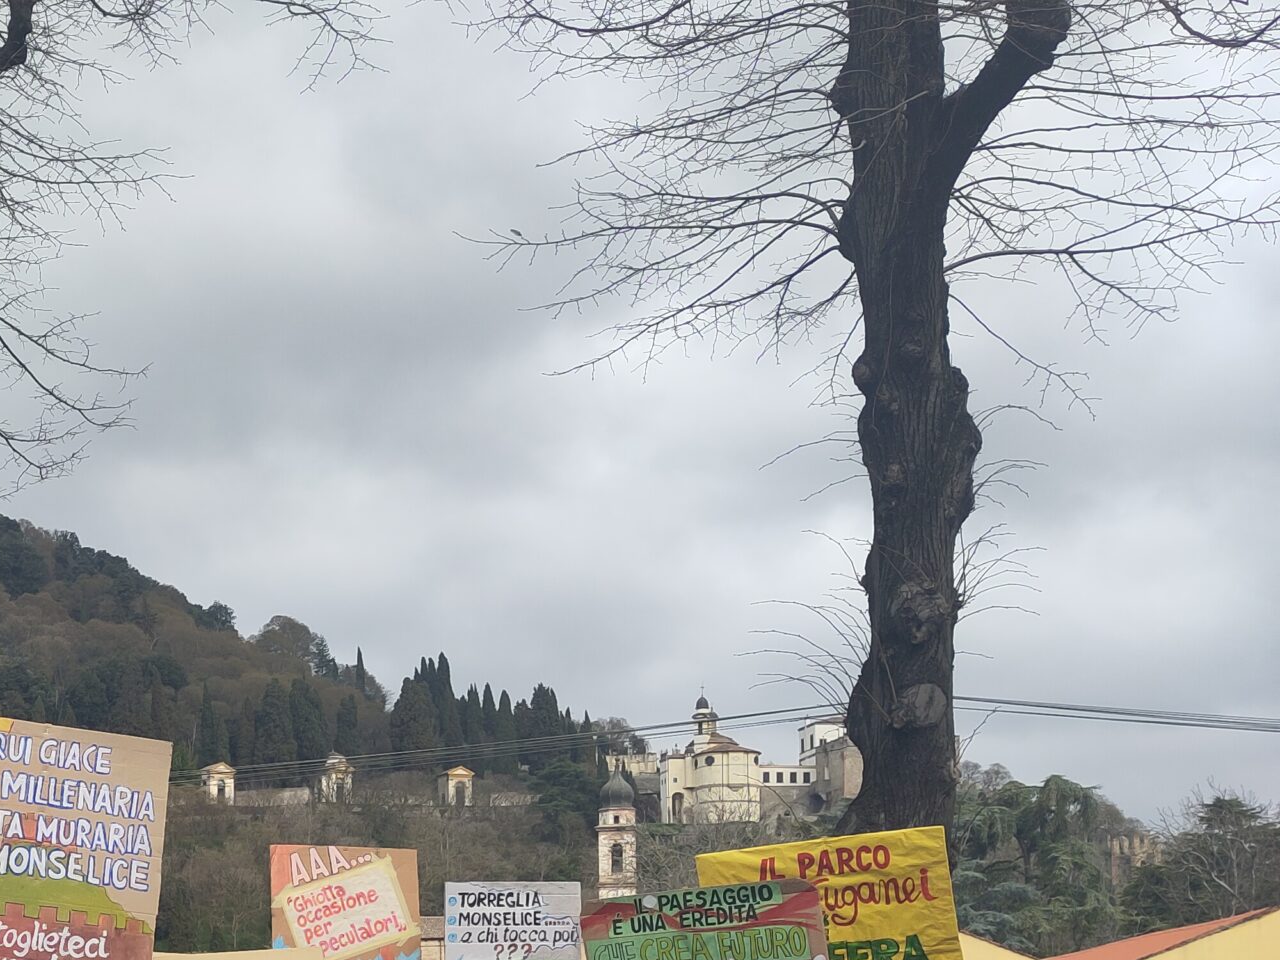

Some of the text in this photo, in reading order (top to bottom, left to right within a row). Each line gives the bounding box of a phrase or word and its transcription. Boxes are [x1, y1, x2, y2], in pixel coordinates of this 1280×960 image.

[39, 738, 112, 776] GIACE
[1, 769, 156, 822] MILLENARIA
[36, 814, 153, 857] MURARIA
[759, 844, 891, 881] IL PARCO
[297, 888, 379, 927] occasione
[458, 891, 542, 908] TORREGLIA
[634, 884, 773, 915] IL PAESAGGIO
[812, 868, 938, 926] uganei
[303, 921, 333, 945] per
[460, 931, 472, 943] a
[477, 927, 498, 943] chi
[503, 927, 549, 942] tocca
[629, 915, 667, 934] UNA
